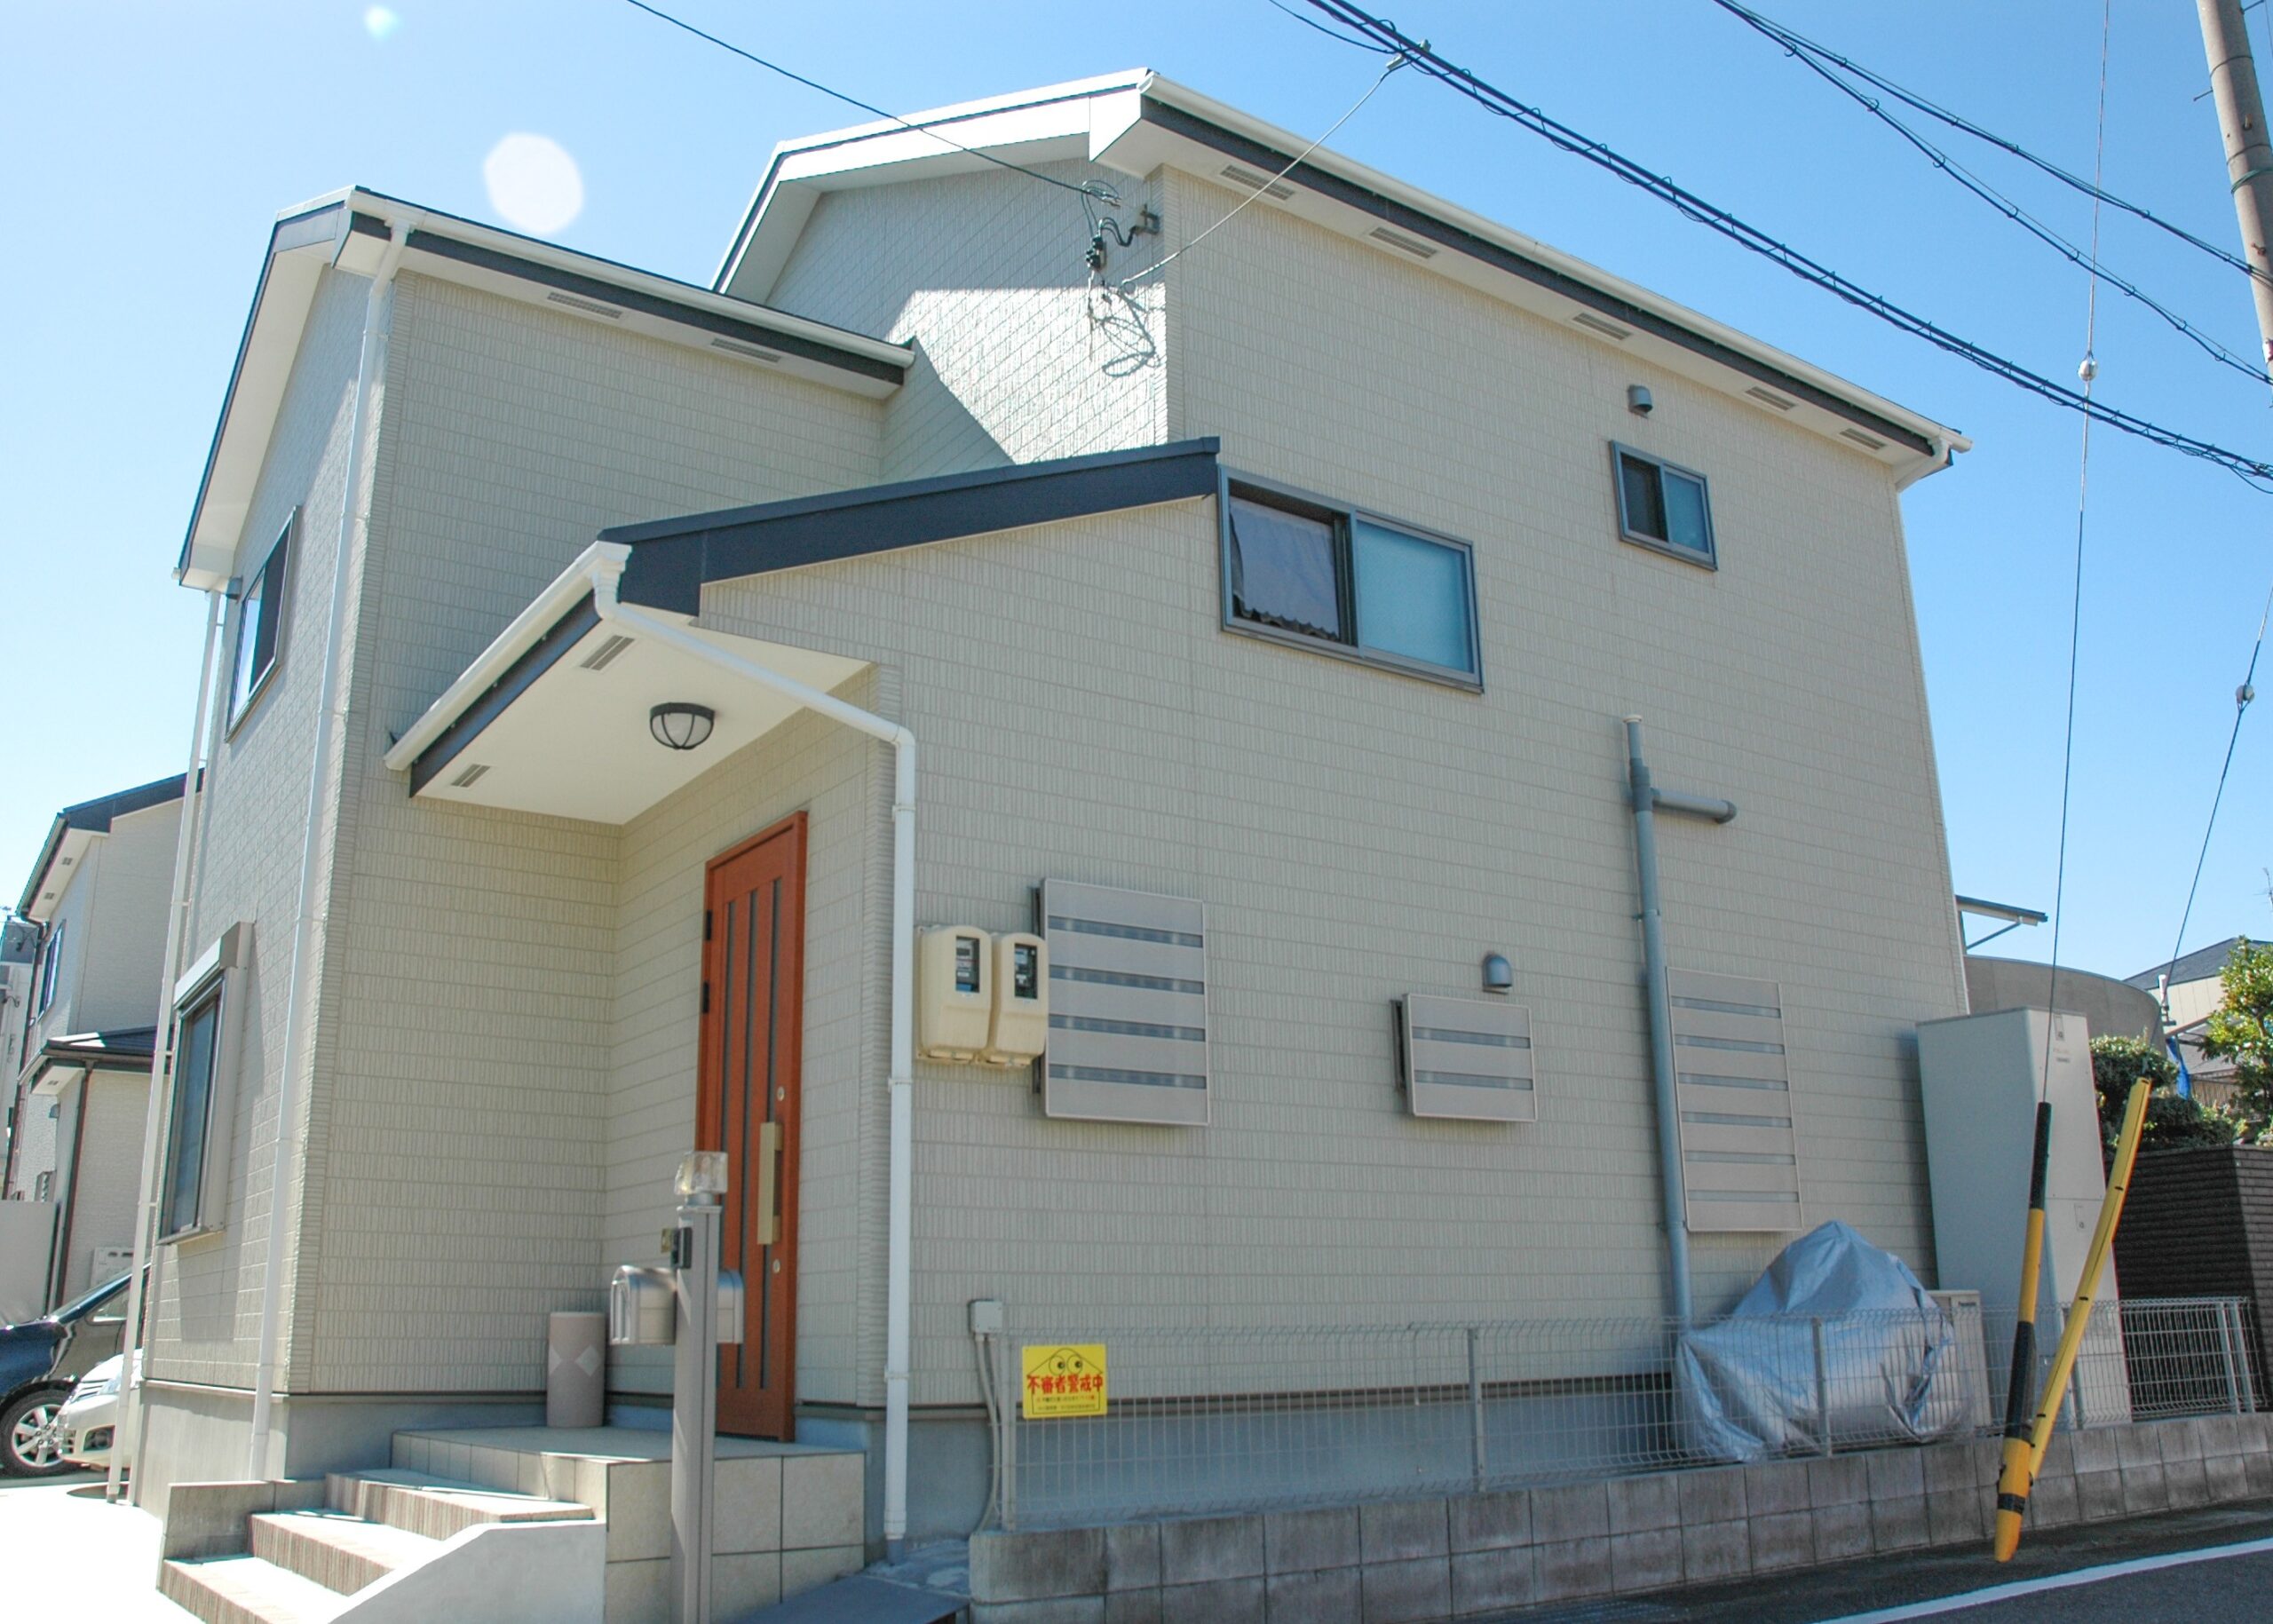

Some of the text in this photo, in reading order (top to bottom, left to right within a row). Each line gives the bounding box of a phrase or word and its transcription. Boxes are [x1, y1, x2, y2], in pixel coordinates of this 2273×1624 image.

[1026, 1374, 1103, 1394] 不審者警戒中
